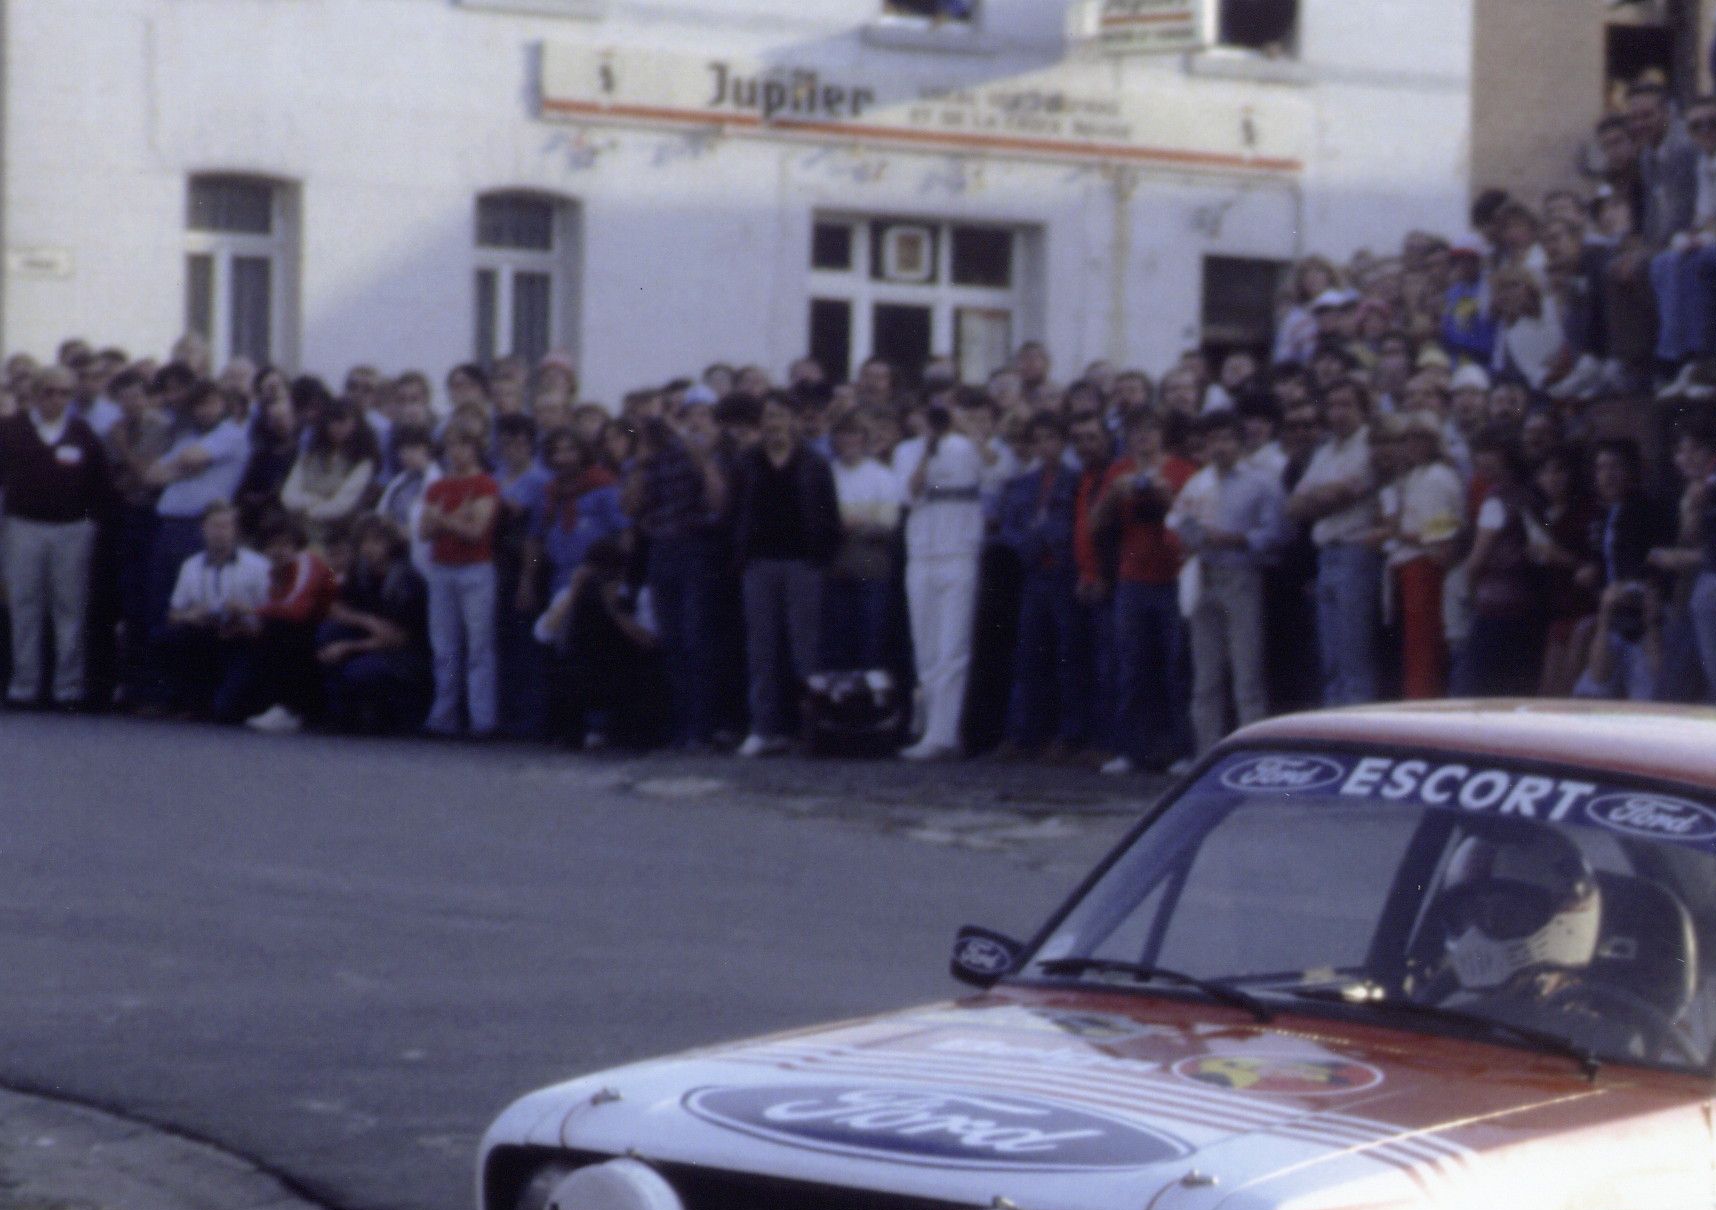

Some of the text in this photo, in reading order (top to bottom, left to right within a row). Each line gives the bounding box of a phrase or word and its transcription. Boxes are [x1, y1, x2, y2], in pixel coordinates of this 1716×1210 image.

[707, 61, 875, 118] Jupiler
[1239, 755, 1702, 834] Ford ESCORT Ford
[763, 1087, 1108, 1152] Ford
